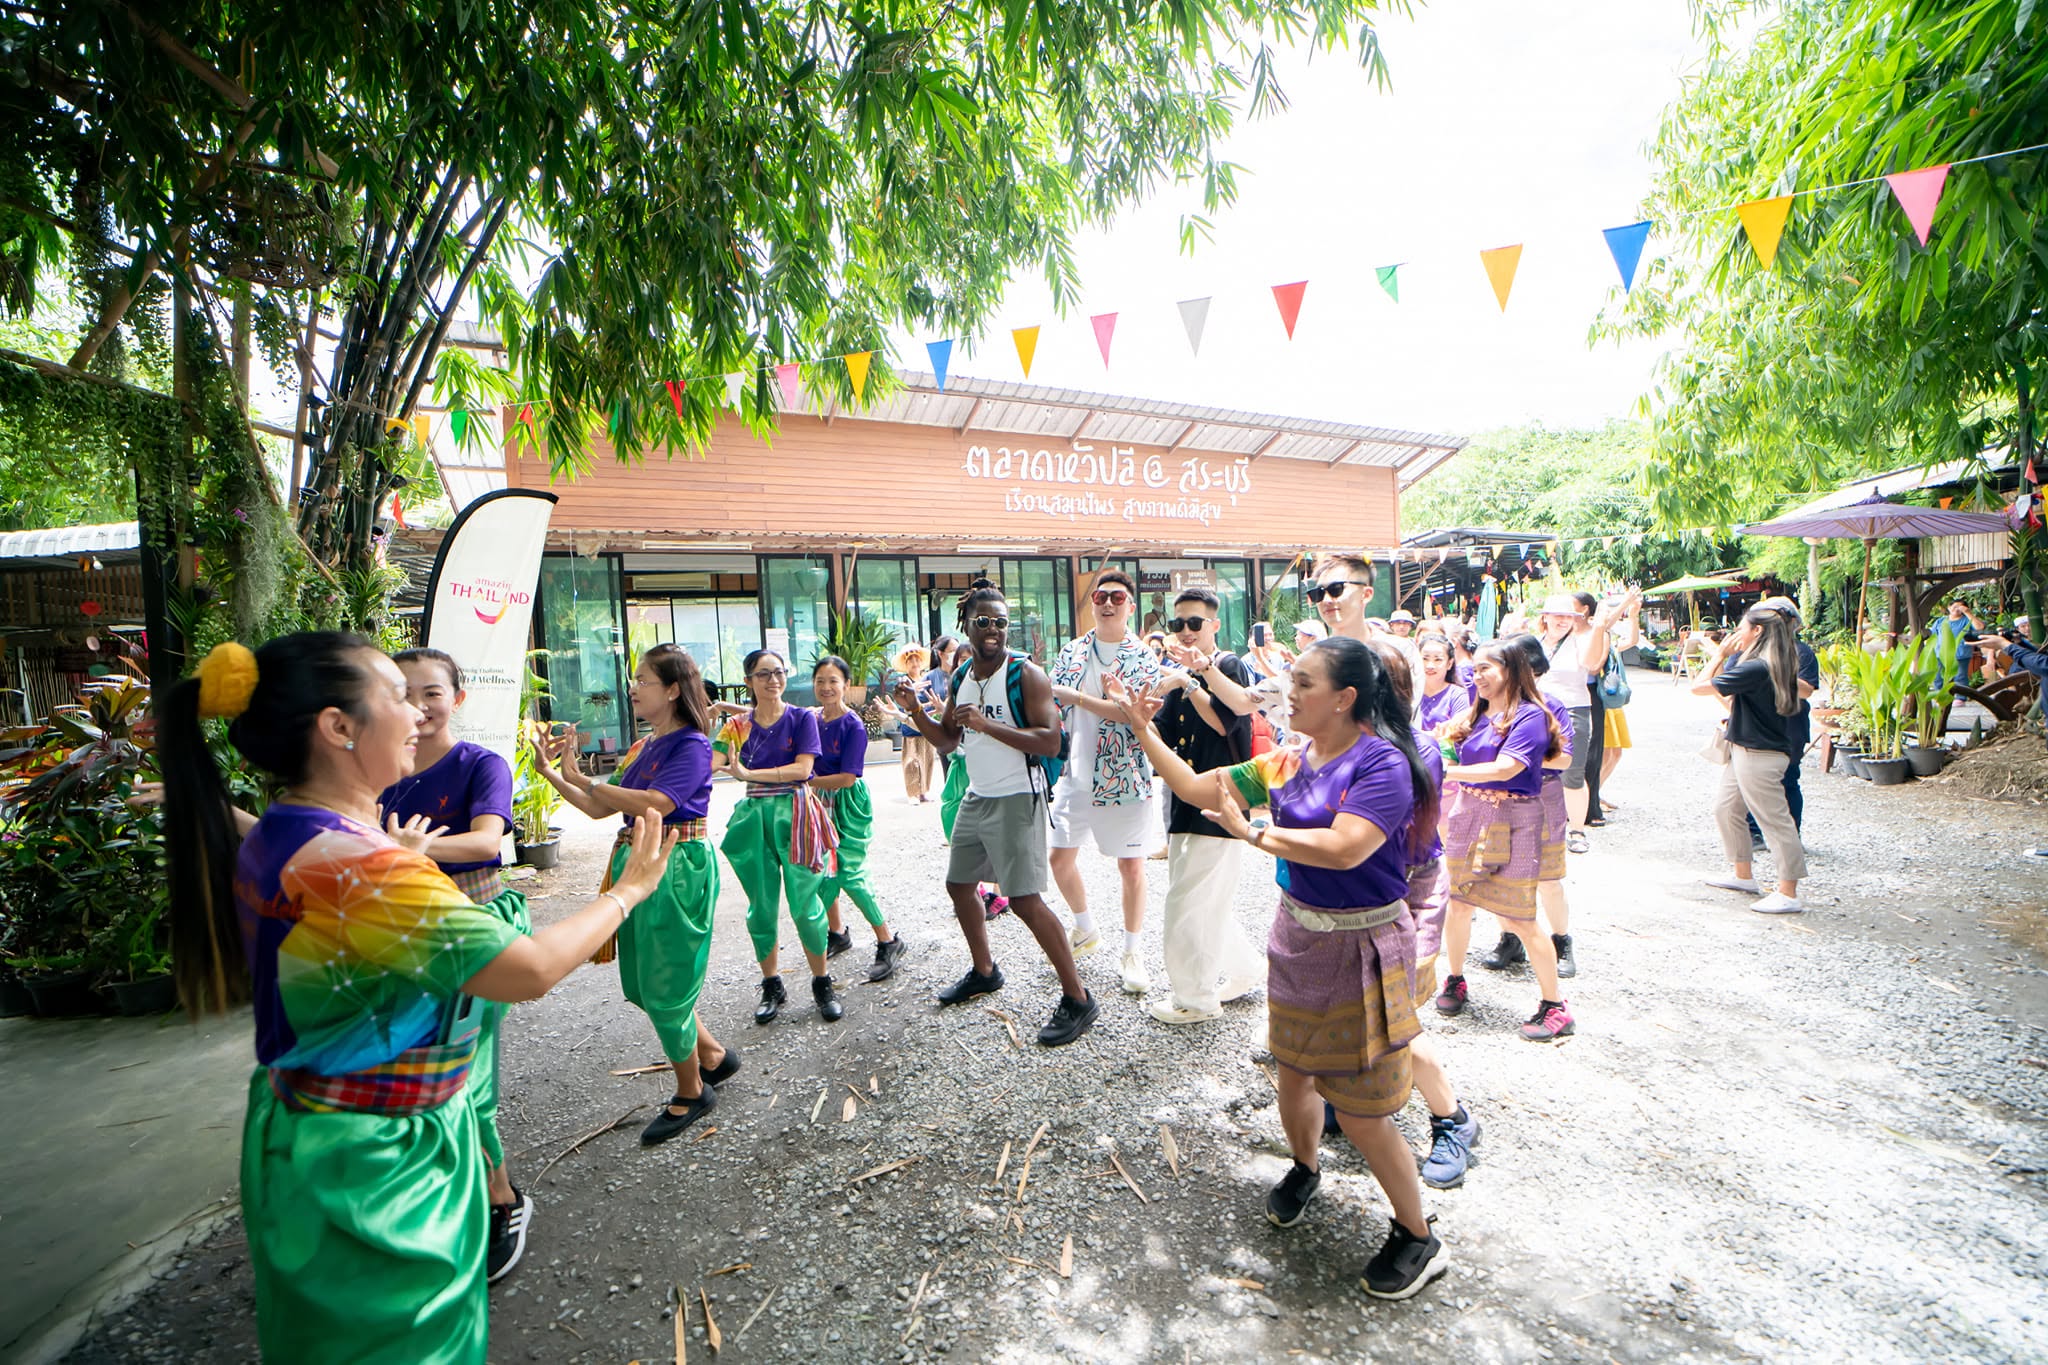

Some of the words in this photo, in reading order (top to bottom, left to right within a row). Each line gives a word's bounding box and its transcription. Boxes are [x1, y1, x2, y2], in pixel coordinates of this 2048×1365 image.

[961, 442, 1135, 487] ตลาดหัวปลี
[1178, 457, 1251, 507] สระบุรี
